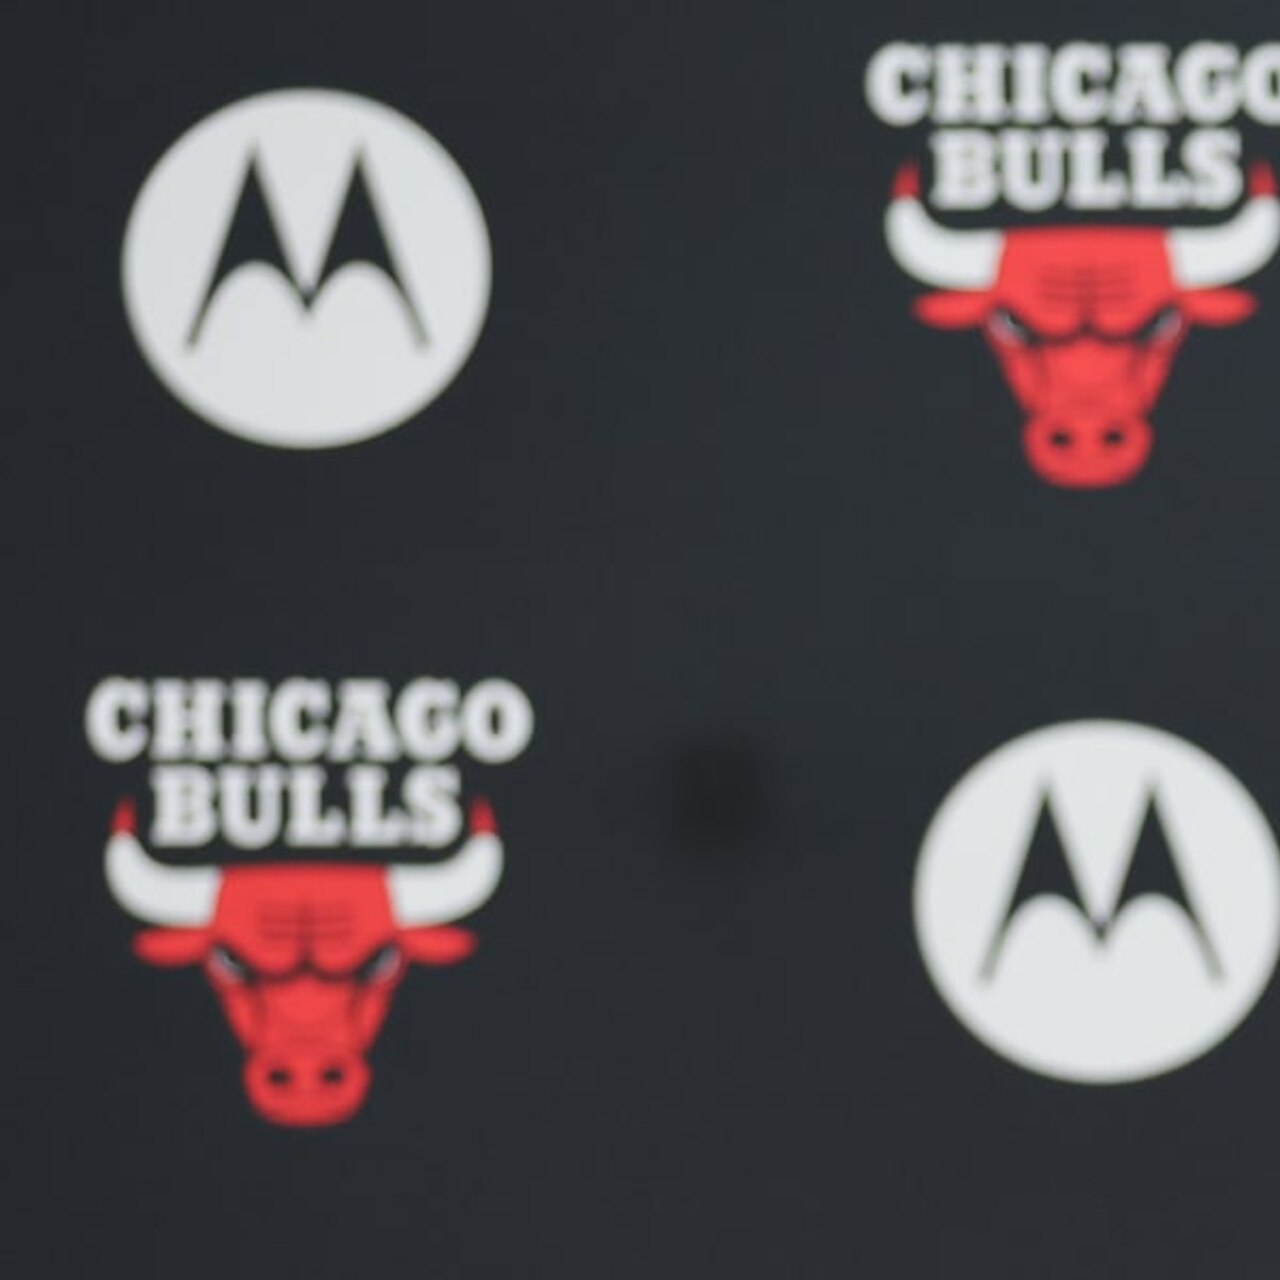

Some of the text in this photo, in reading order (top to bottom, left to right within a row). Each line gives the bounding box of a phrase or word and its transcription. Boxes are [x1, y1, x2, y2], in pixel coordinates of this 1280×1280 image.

[931, 129, 1247, 211] BULLS
[86, 678, 533, 762] CHICAGO
[150, 765, 465, 848] BULLS
